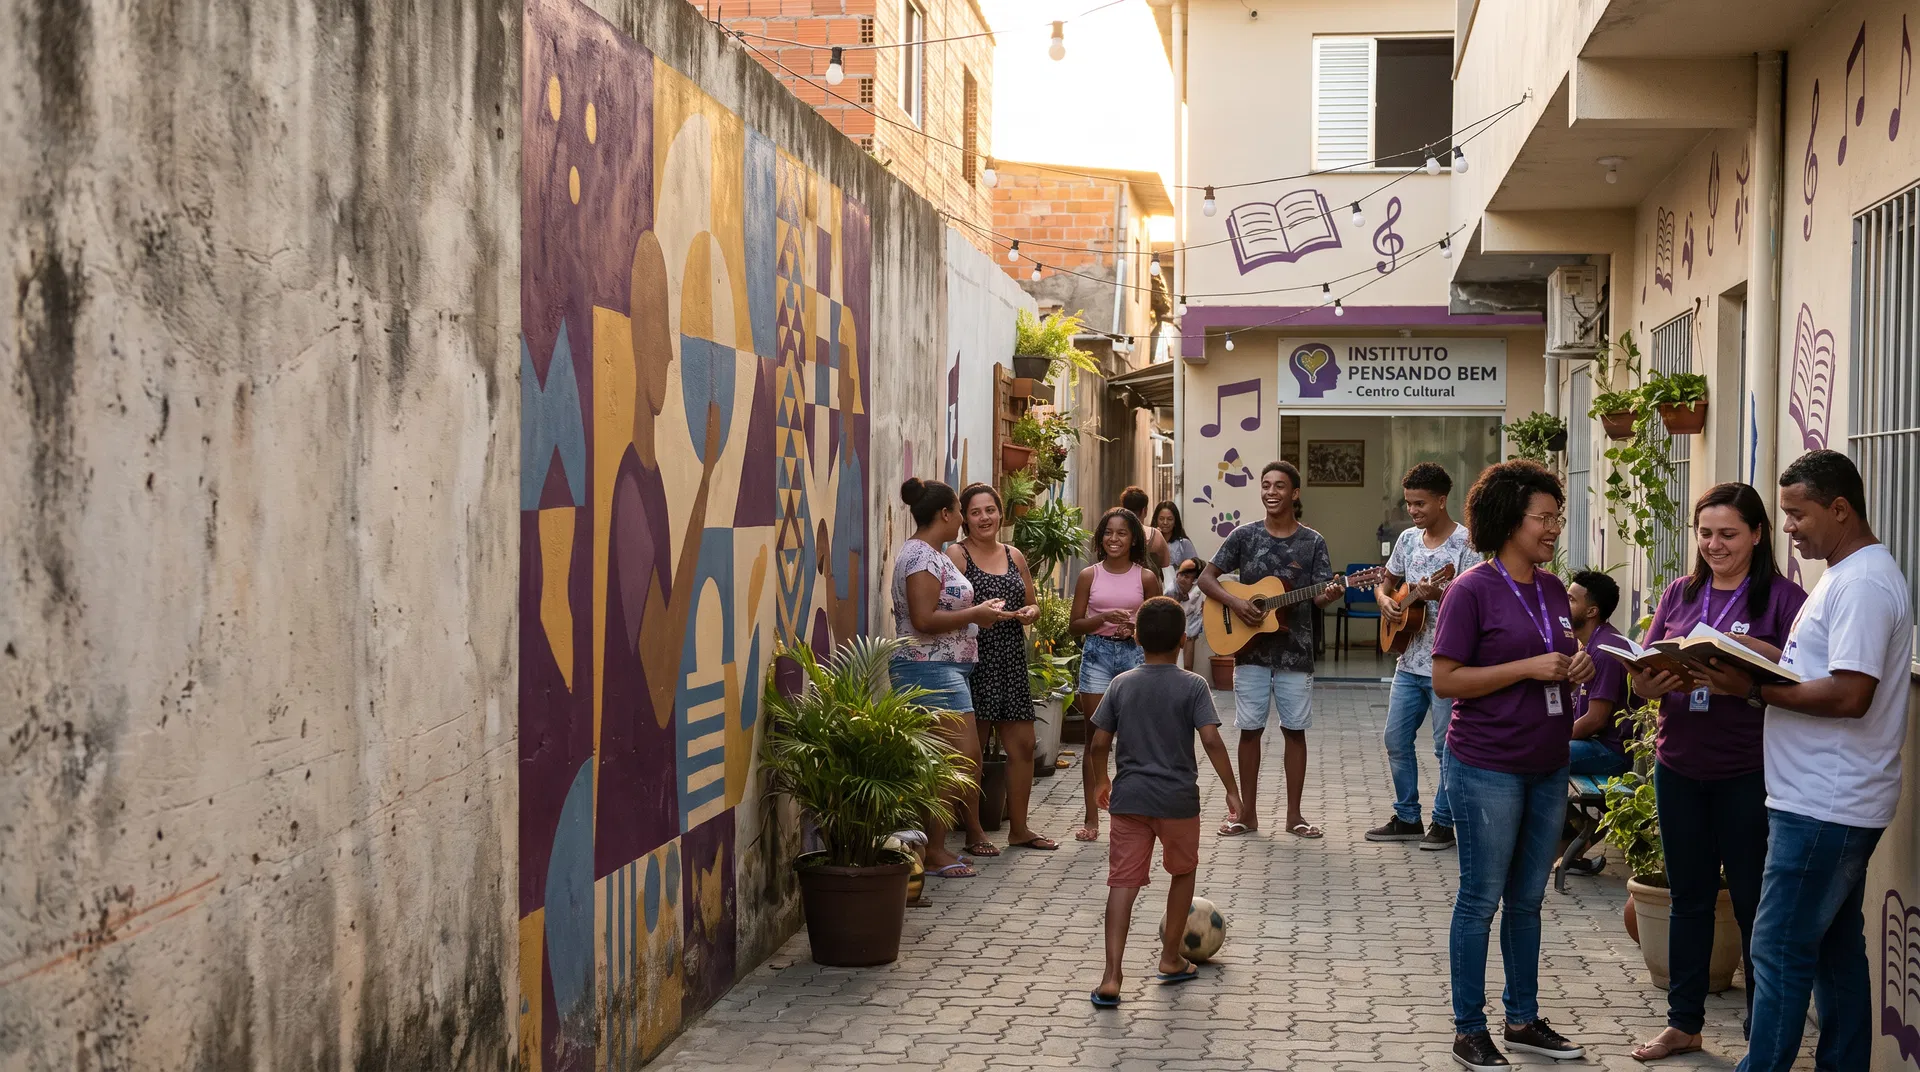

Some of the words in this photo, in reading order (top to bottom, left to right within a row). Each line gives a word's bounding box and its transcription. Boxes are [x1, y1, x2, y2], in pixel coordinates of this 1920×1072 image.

[1348, 346, 1448, 361] INSTITUTO
[1348, 366, 1452, 381] PENSANDO
[1457, 366, 1497, 381] BEM
[1356, 386, 1400, 397] Centro
[1403, 386, 1456, 397] Cultural
